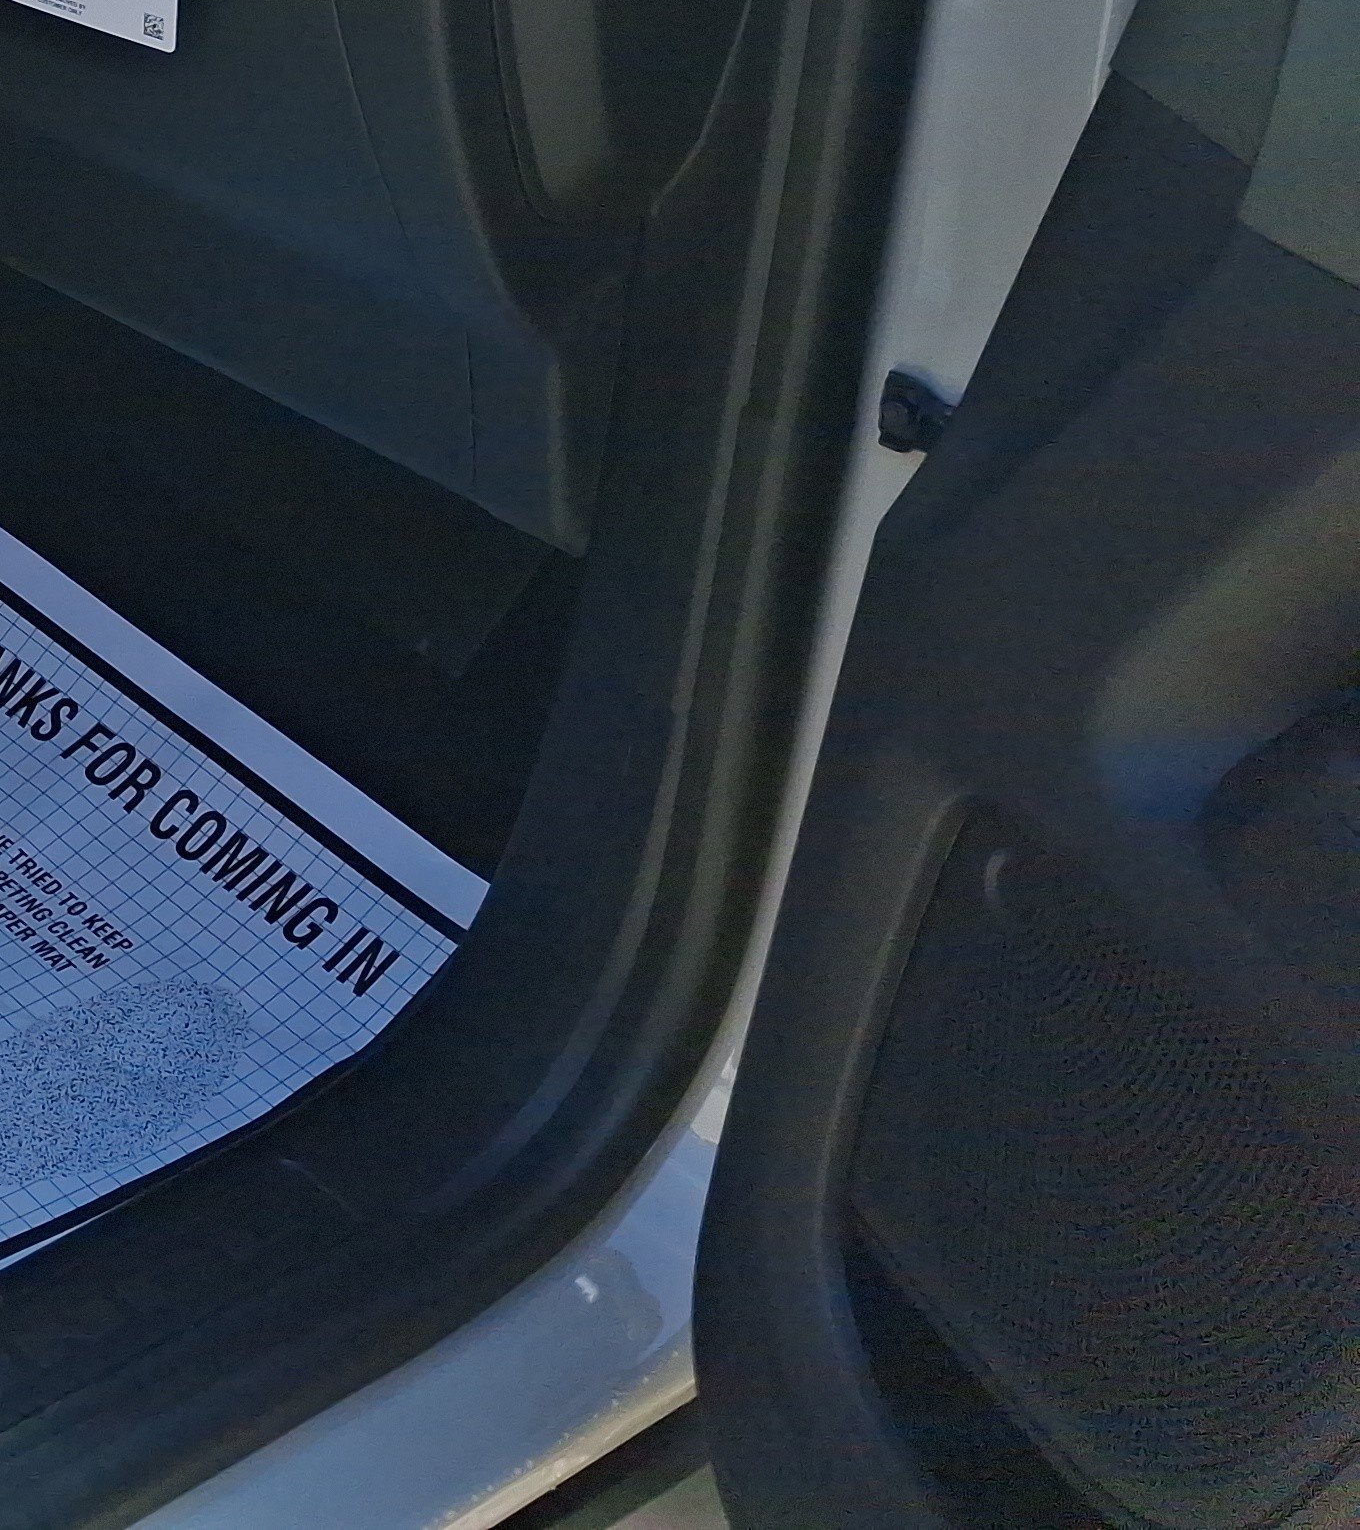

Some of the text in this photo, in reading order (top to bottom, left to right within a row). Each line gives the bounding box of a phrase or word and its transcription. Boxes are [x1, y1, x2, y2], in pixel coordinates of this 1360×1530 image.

[9, 847, 63, 896] TRIED
[58, 891, 88, 917] TO
[81, 913, 134, 951] KEEP
[60, 722, 162, 815] FOR
[148, 788, 340, 952] COMING
[321, 926, 401, 999] IN
[30, 939, 78, 973] MAT
[47, 920, 111, 970] CLEAN
